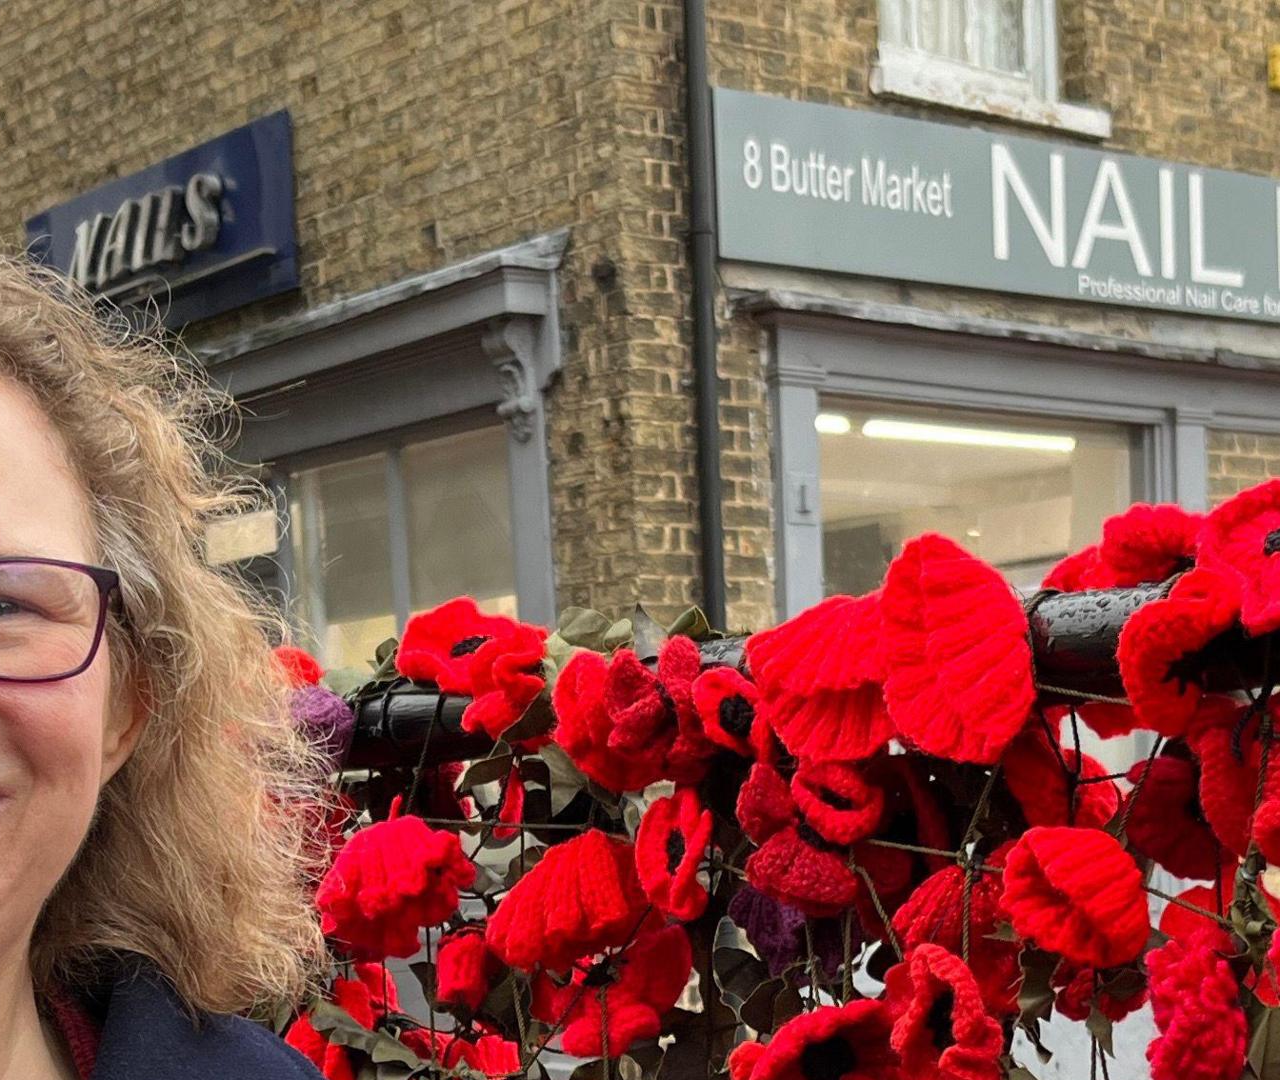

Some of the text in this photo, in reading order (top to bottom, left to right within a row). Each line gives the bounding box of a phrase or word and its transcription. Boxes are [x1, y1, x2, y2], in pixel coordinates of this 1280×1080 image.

[743, 138, 953, 219] 8 Butter Market
[991, 142, 1245, 288] NAIL
[70, 173, 222, 288] NAILS
[1078, 274, 1181, 305] Professional
[1186, 286, 1218, 311] Nail
[1221, 292, 1259, 315] Care
